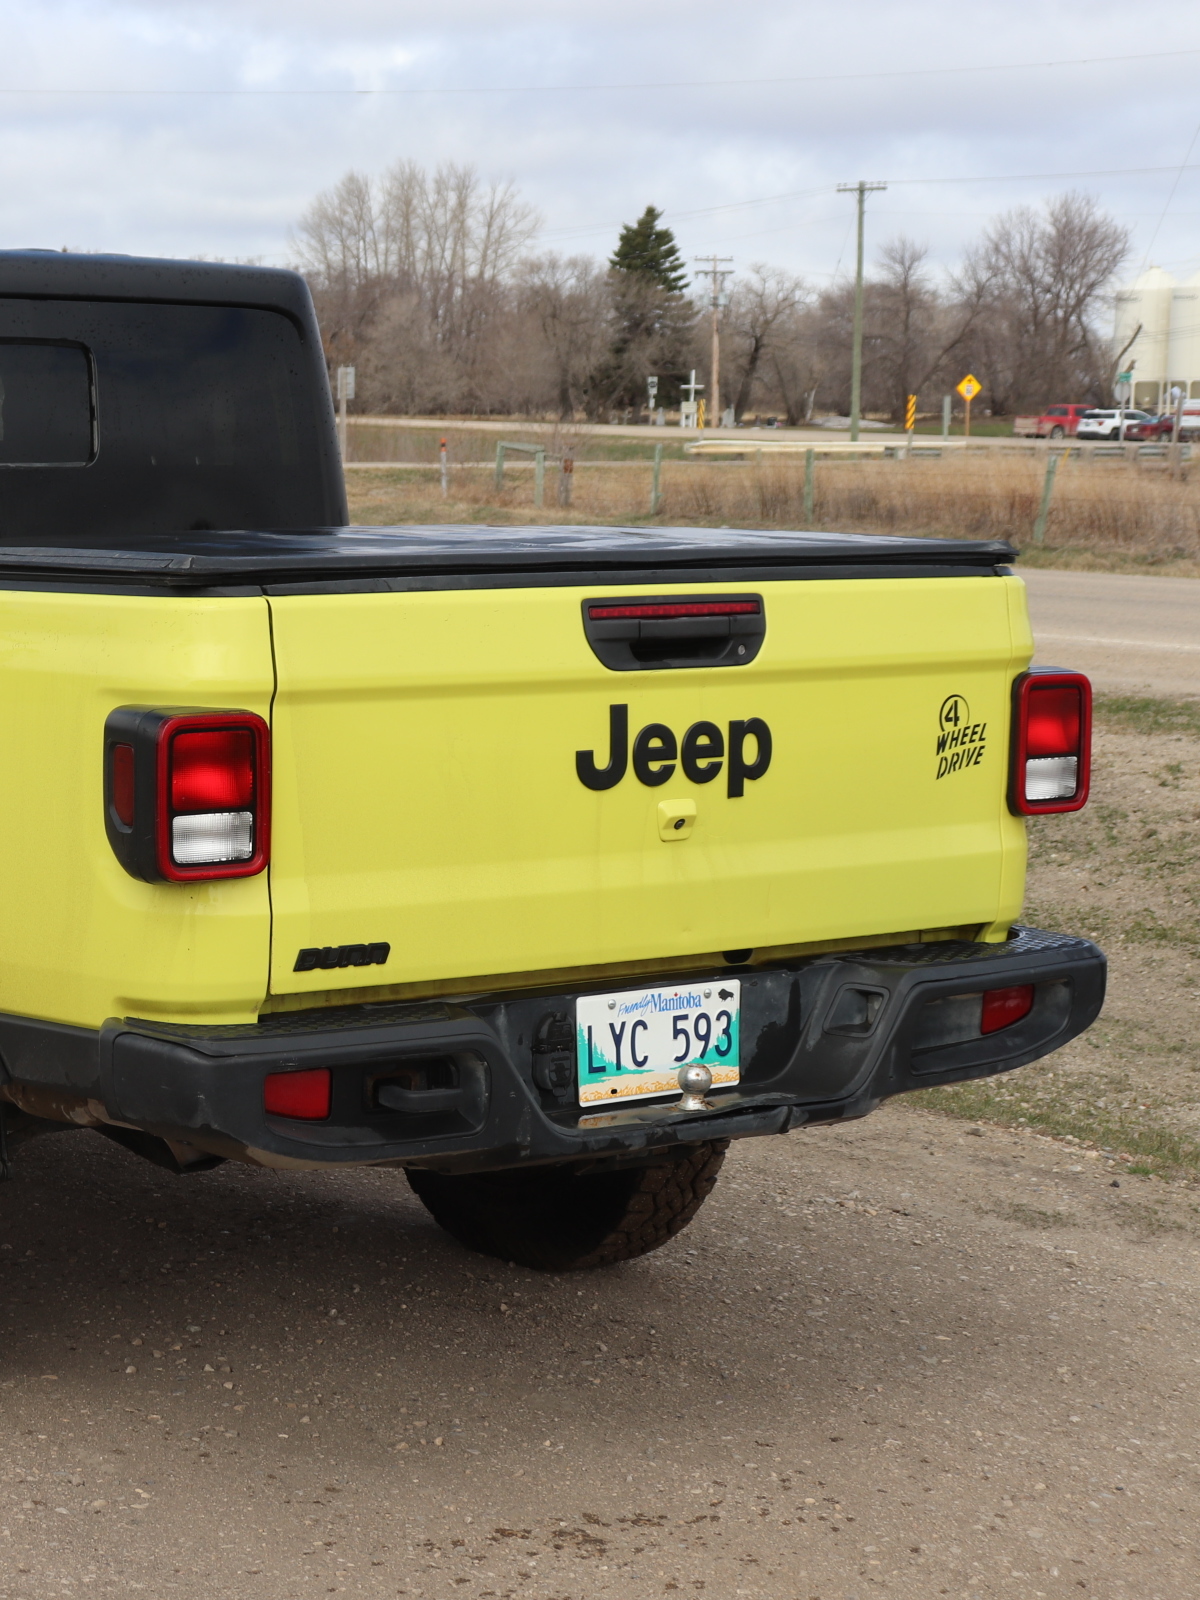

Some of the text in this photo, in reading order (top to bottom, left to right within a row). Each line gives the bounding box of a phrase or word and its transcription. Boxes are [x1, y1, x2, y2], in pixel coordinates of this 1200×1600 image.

[944, 700, 960, 727] 4
[575, 703, 773, 799] Jeep
[936, 722, 987, 756] WHEEL
[936, 745, 986, 780] DRIVE
[617, 992, 702, 1017] Friendly Manitoba
[587, 1010, 732, 1074] LYC 593
